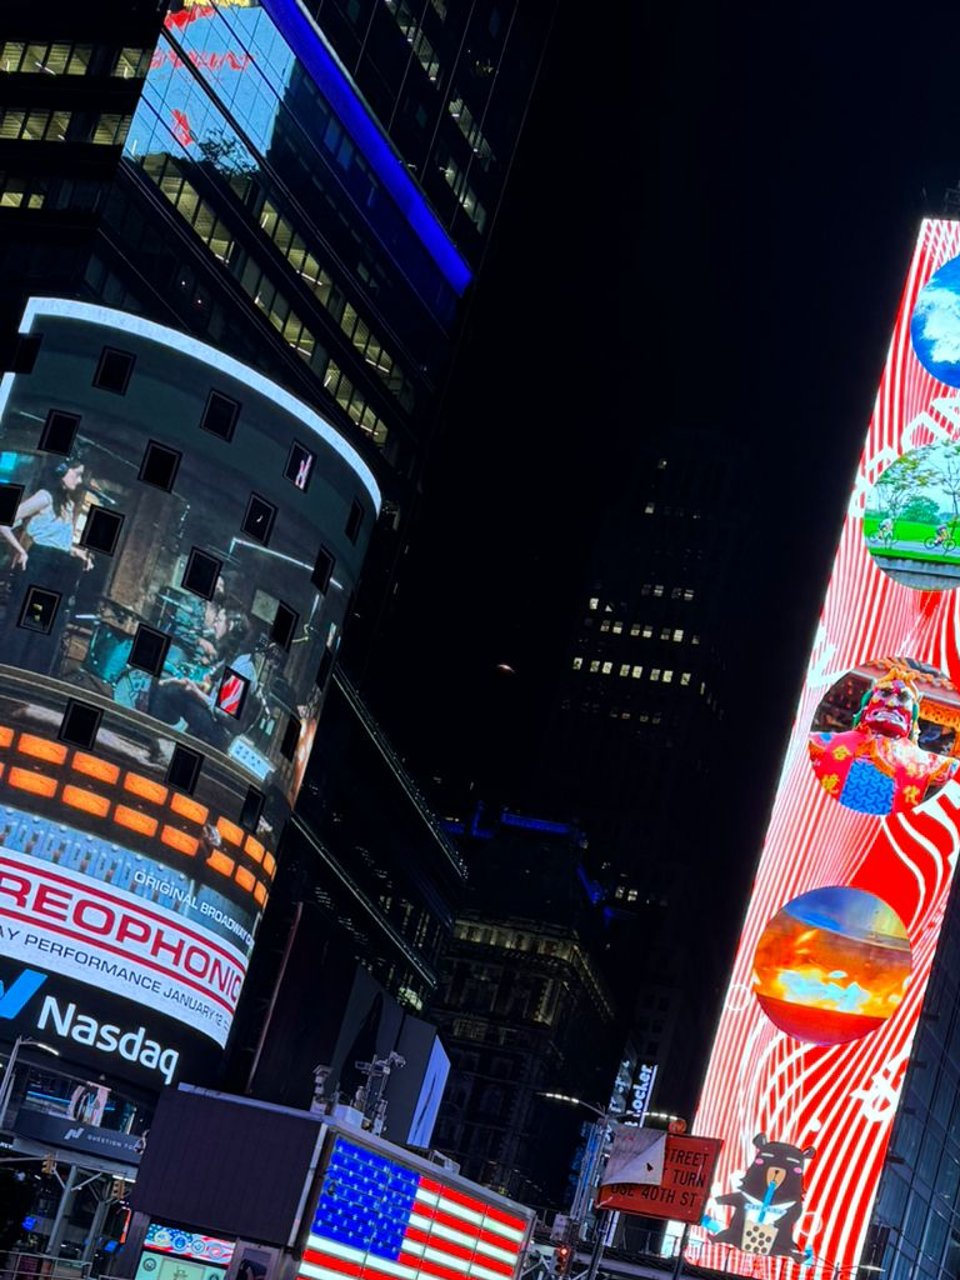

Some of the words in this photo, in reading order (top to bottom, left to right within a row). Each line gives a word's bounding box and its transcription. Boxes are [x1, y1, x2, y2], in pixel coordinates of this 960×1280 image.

[134, 870, 198, 910] ORIGINAL
[24, 933, 163, 994] PERFORMANCE
[164, 987, 215, 1020] JANUARY
[36, 995, 180, 1086] Nasdaq
[666, 1148, 709, 1167] TREET
[674, 1169, 705, 1188] TURN
[610, 1184, 634, 1197] USE
[641, 1185, 675, 1203] 40TH
[680, 1191, 698, 1208] ST
